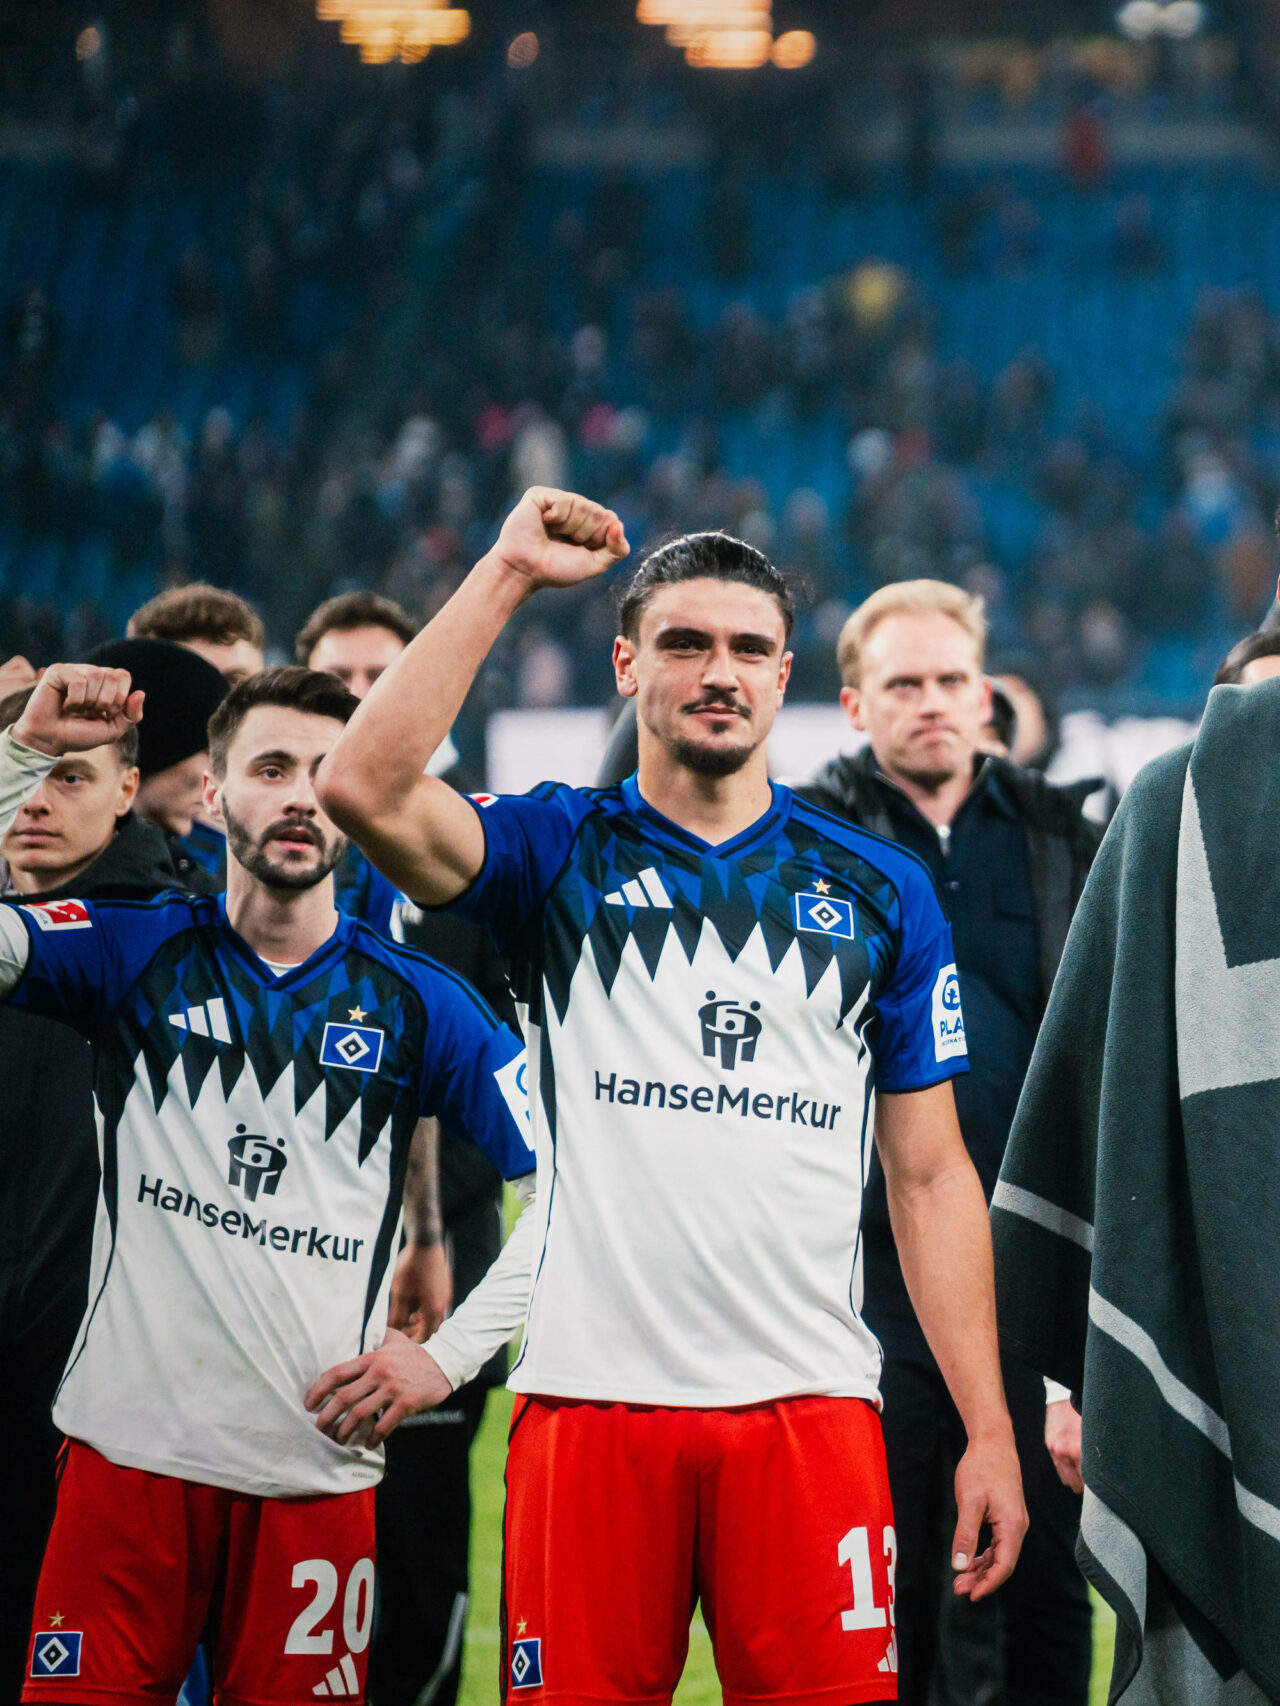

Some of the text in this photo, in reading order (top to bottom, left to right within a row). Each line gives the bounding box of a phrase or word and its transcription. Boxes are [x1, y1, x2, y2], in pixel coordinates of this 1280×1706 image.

[594, 1070, 842, 1131] HanseMerkur
[137, 1173, 365, 1263] HanseMerkur
[283, 1557, 375, 1655] 20
[837, 1525, 898, 1632] 13
